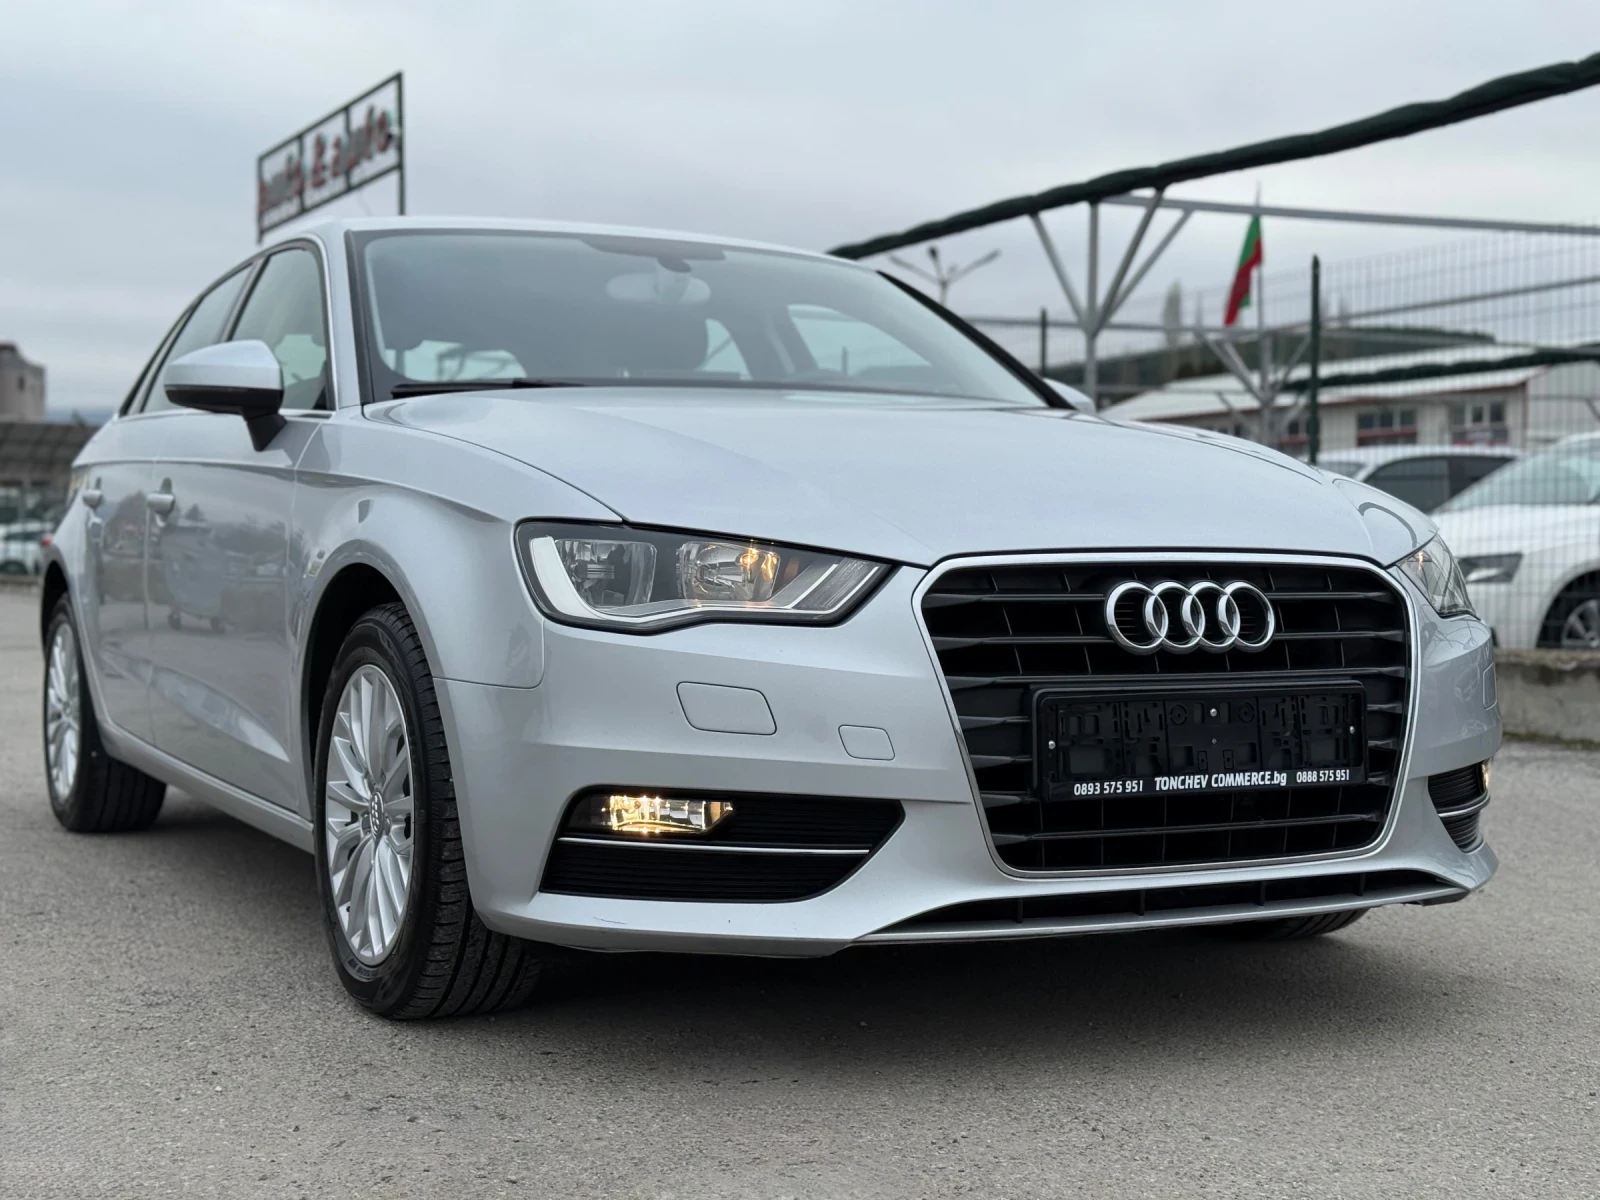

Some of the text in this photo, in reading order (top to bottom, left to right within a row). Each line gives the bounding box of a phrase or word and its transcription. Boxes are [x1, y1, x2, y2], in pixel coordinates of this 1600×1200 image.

[1073, 769, 1350, 796] 0893 575 951 TONCHEV COMMERCE.bg 0888 575 951
